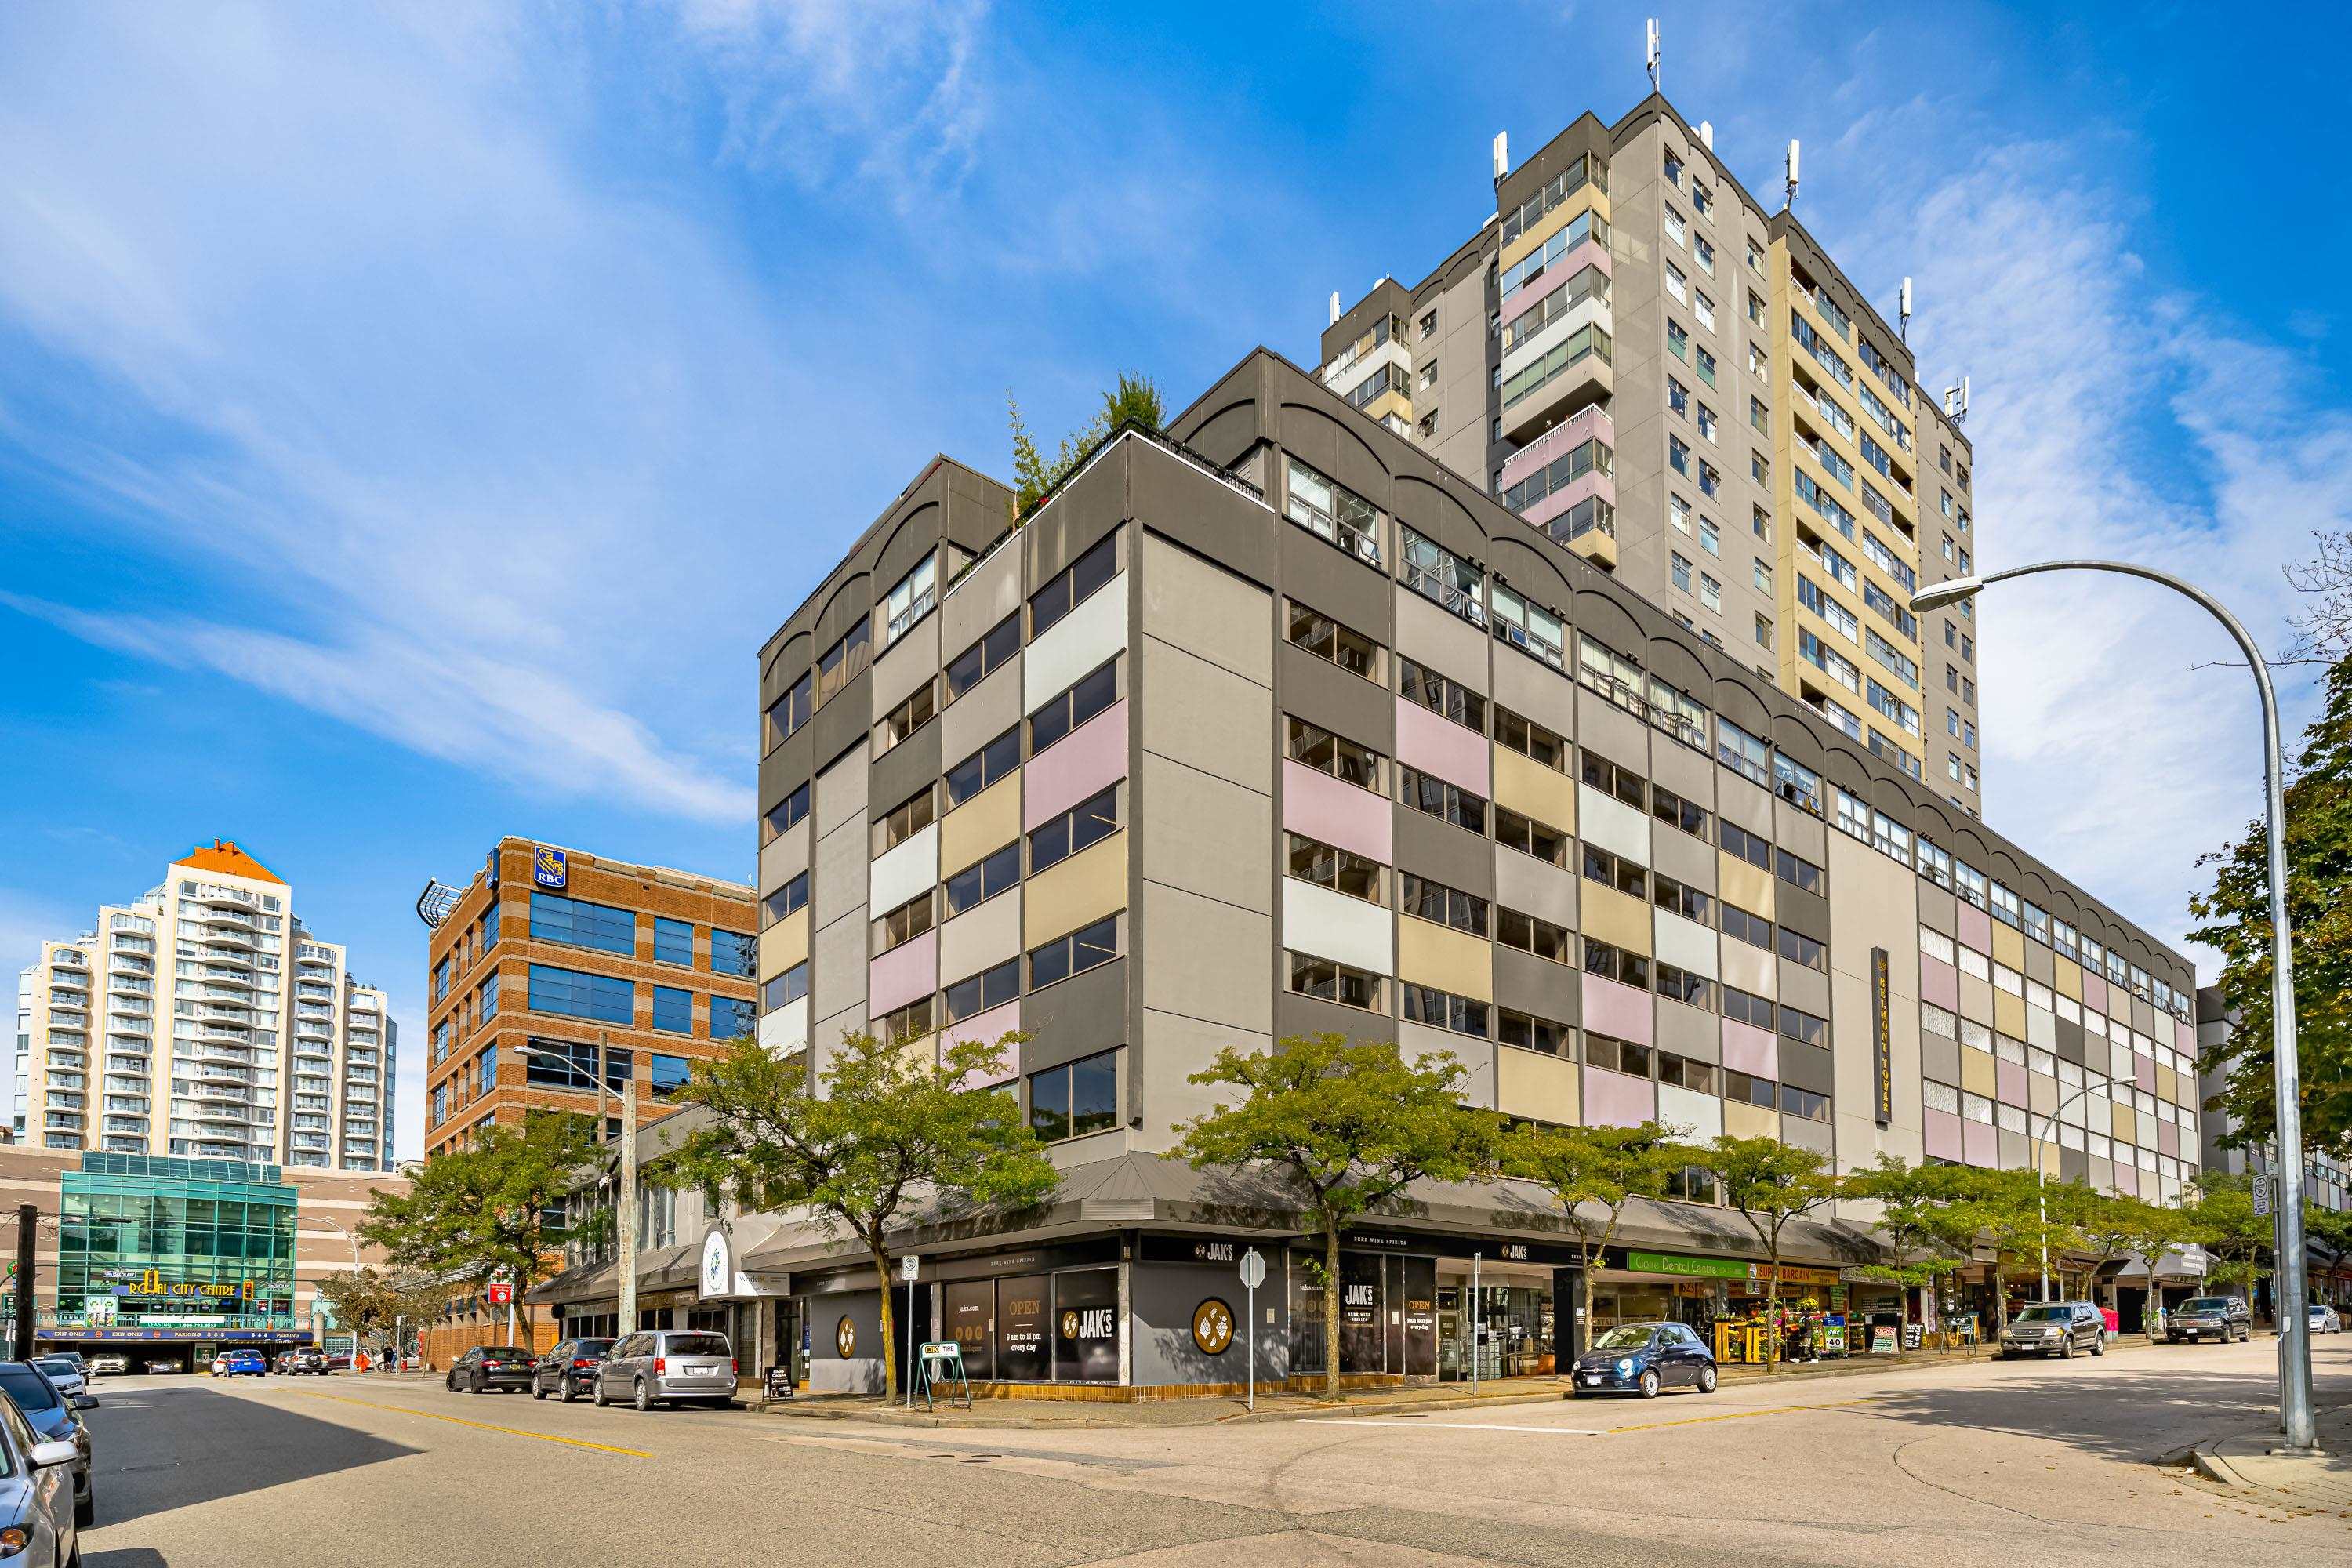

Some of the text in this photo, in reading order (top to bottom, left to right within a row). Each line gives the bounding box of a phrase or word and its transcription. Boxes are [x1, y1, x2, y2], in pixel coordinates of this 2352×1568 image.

[539, 873, 562, 884] RBC
[1879, 977, 1888, 1052] BELMONT
[1207, 1243, 1233, 1261] JAK'S
[1510, 1245, 1527, 1260] JAK'S
[1636, 1256, 1659, 1269] Claire
[1662, 1258, 1689, 1272] Dental
[1692, 1261, 1717, 1274] Centre
[1782, 1269, 1809, 1280] BARGAIN
[129, 1283, 235, 1296] ROAL CITY CENTRE
[1345, 1285, 1373, 1305] JAK'S
[959, 1305, 979, 1313] jaks.com
[1009, 1300, 1040, 1315] OPEN
[1409, 1301, 1431, 1310] OPEN
[1080, 1309, 1112, 1338] JAK'S
[1026, 1343, 1036, 1352] day
